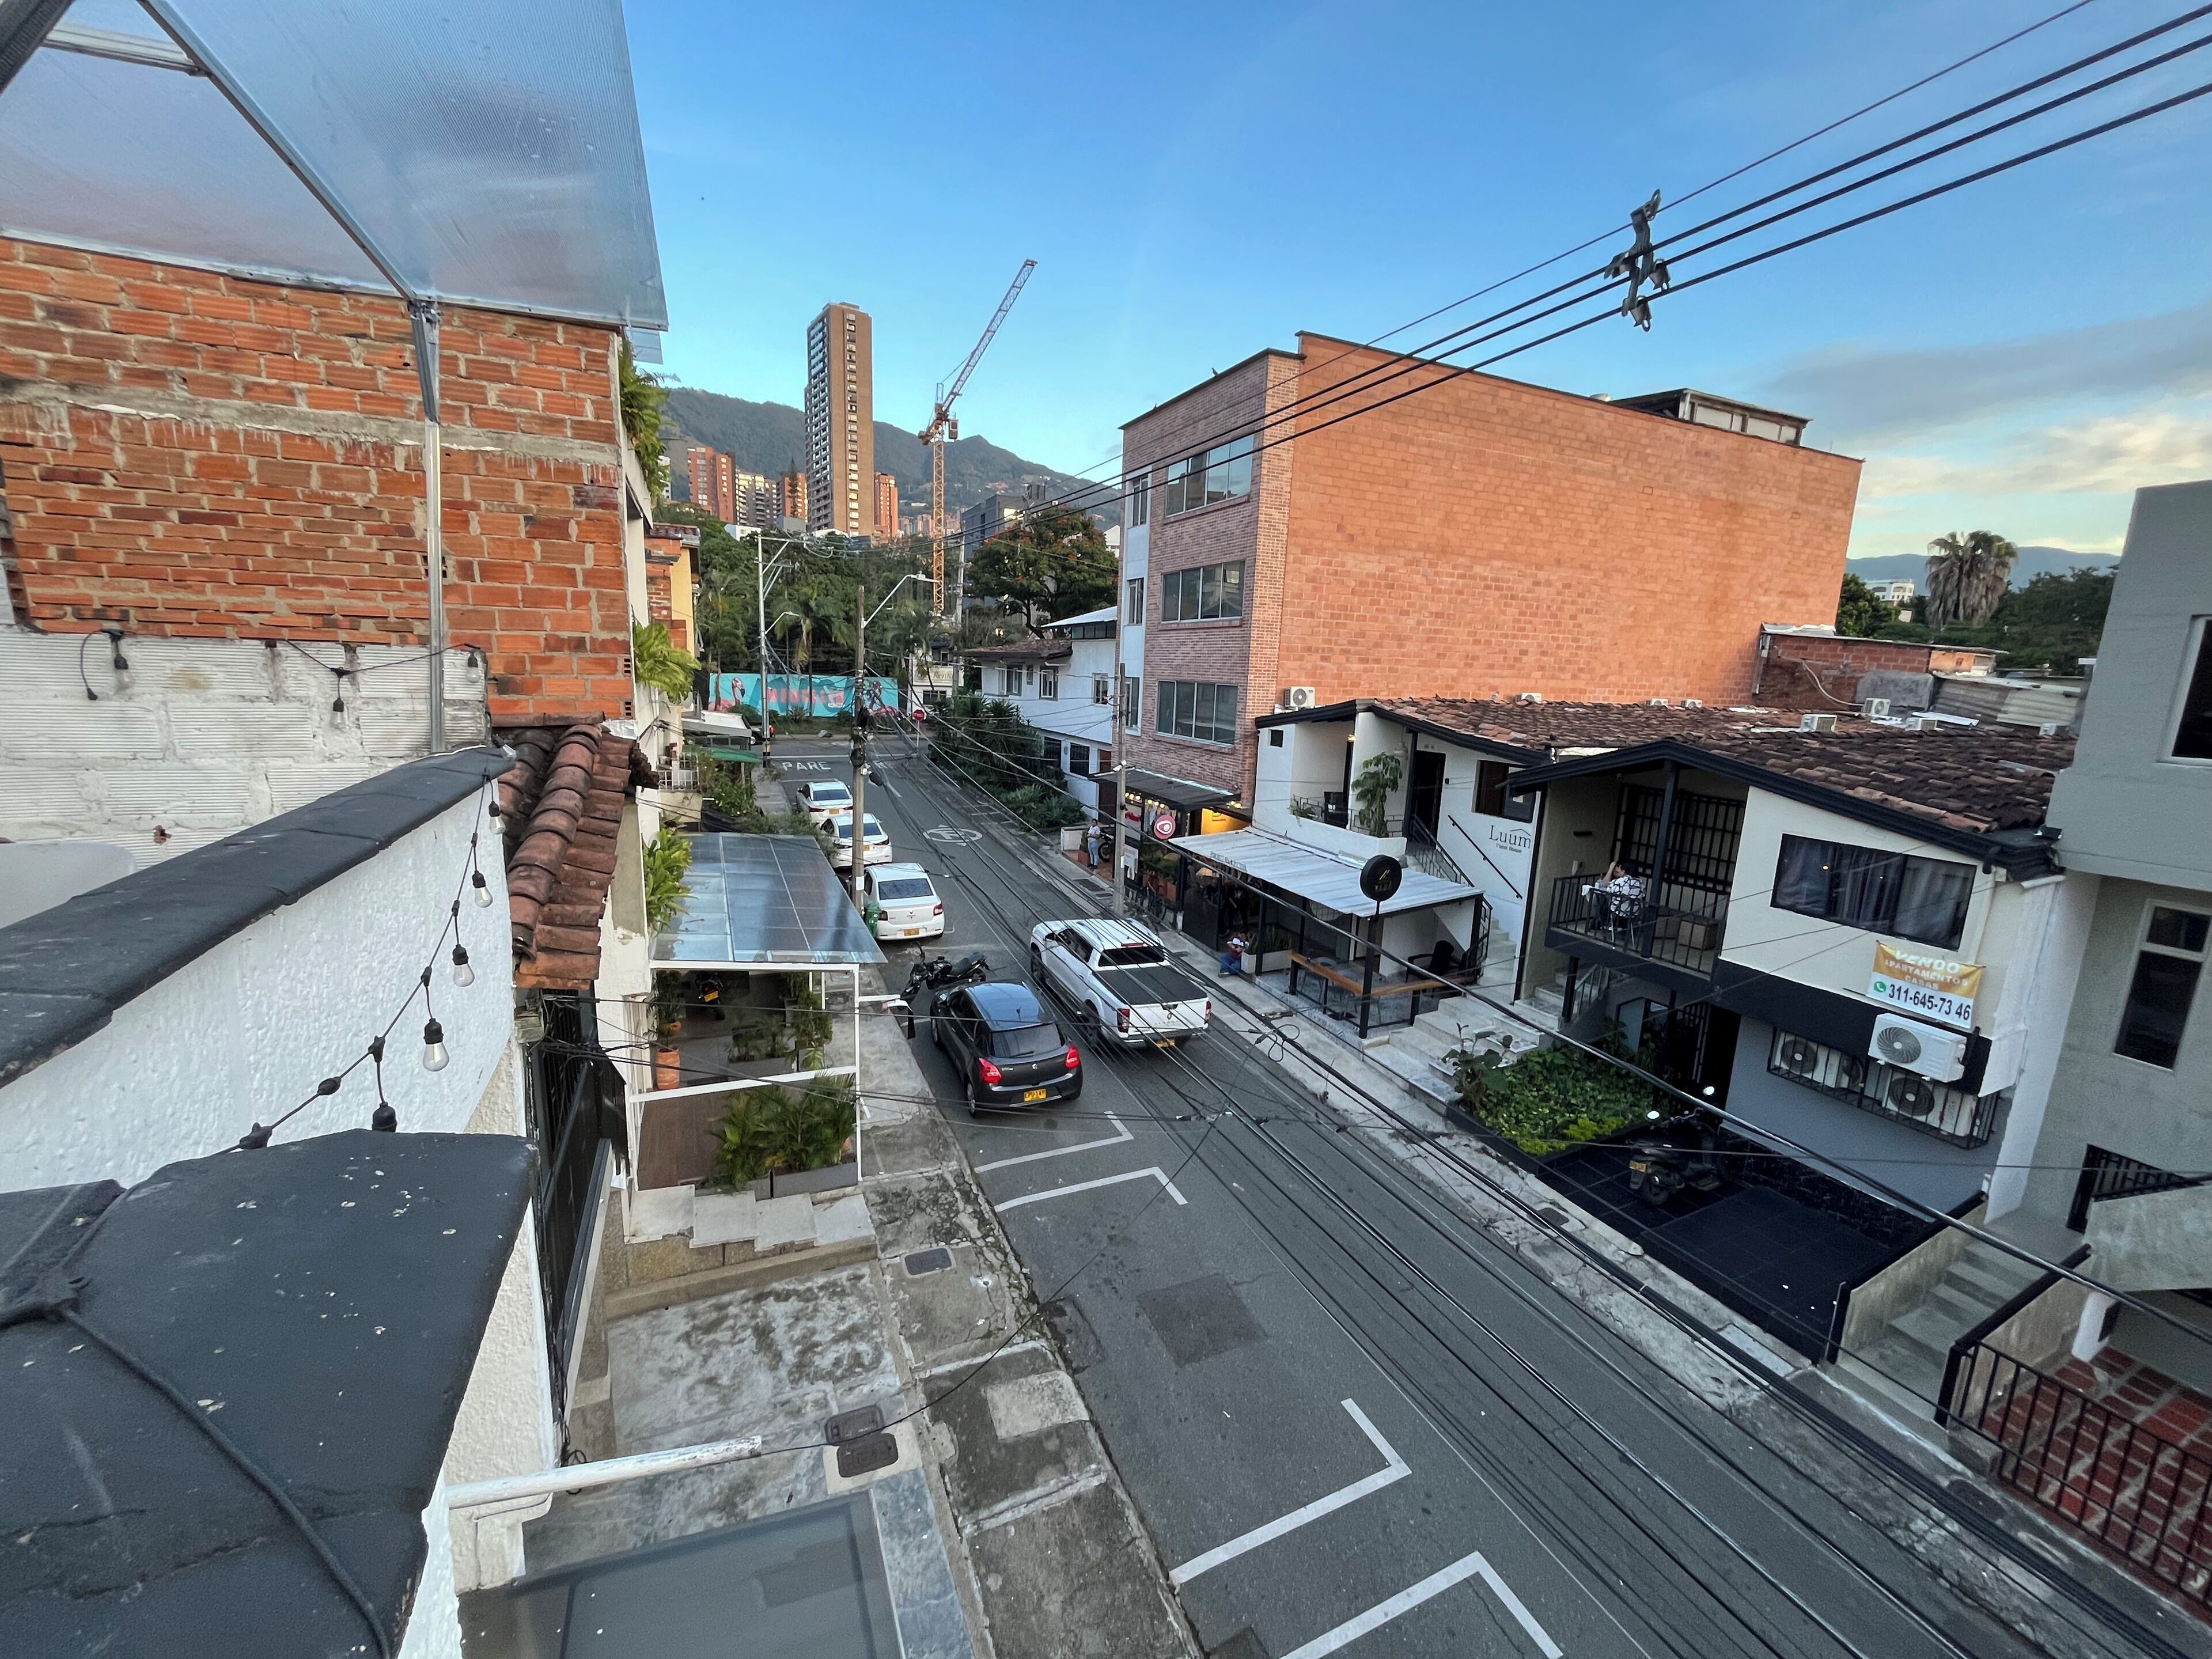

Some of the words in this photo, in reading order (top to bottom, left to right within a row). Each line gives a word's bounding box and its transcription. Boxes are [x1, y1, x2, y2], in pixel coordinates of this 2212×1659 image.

[782, 762, 831, 771] PARE
[1489, 825, 1531, 849] Luum
[1884, 959, 1968, 986] APARTAMENTOS
[1895, 950, 1960, 974] VENDO
[1905, 975, 1940, 990] CASAS
[1889, 984, 1952, 1015] 311-645-73
[1955, 1003, 1971, 1020] 46
